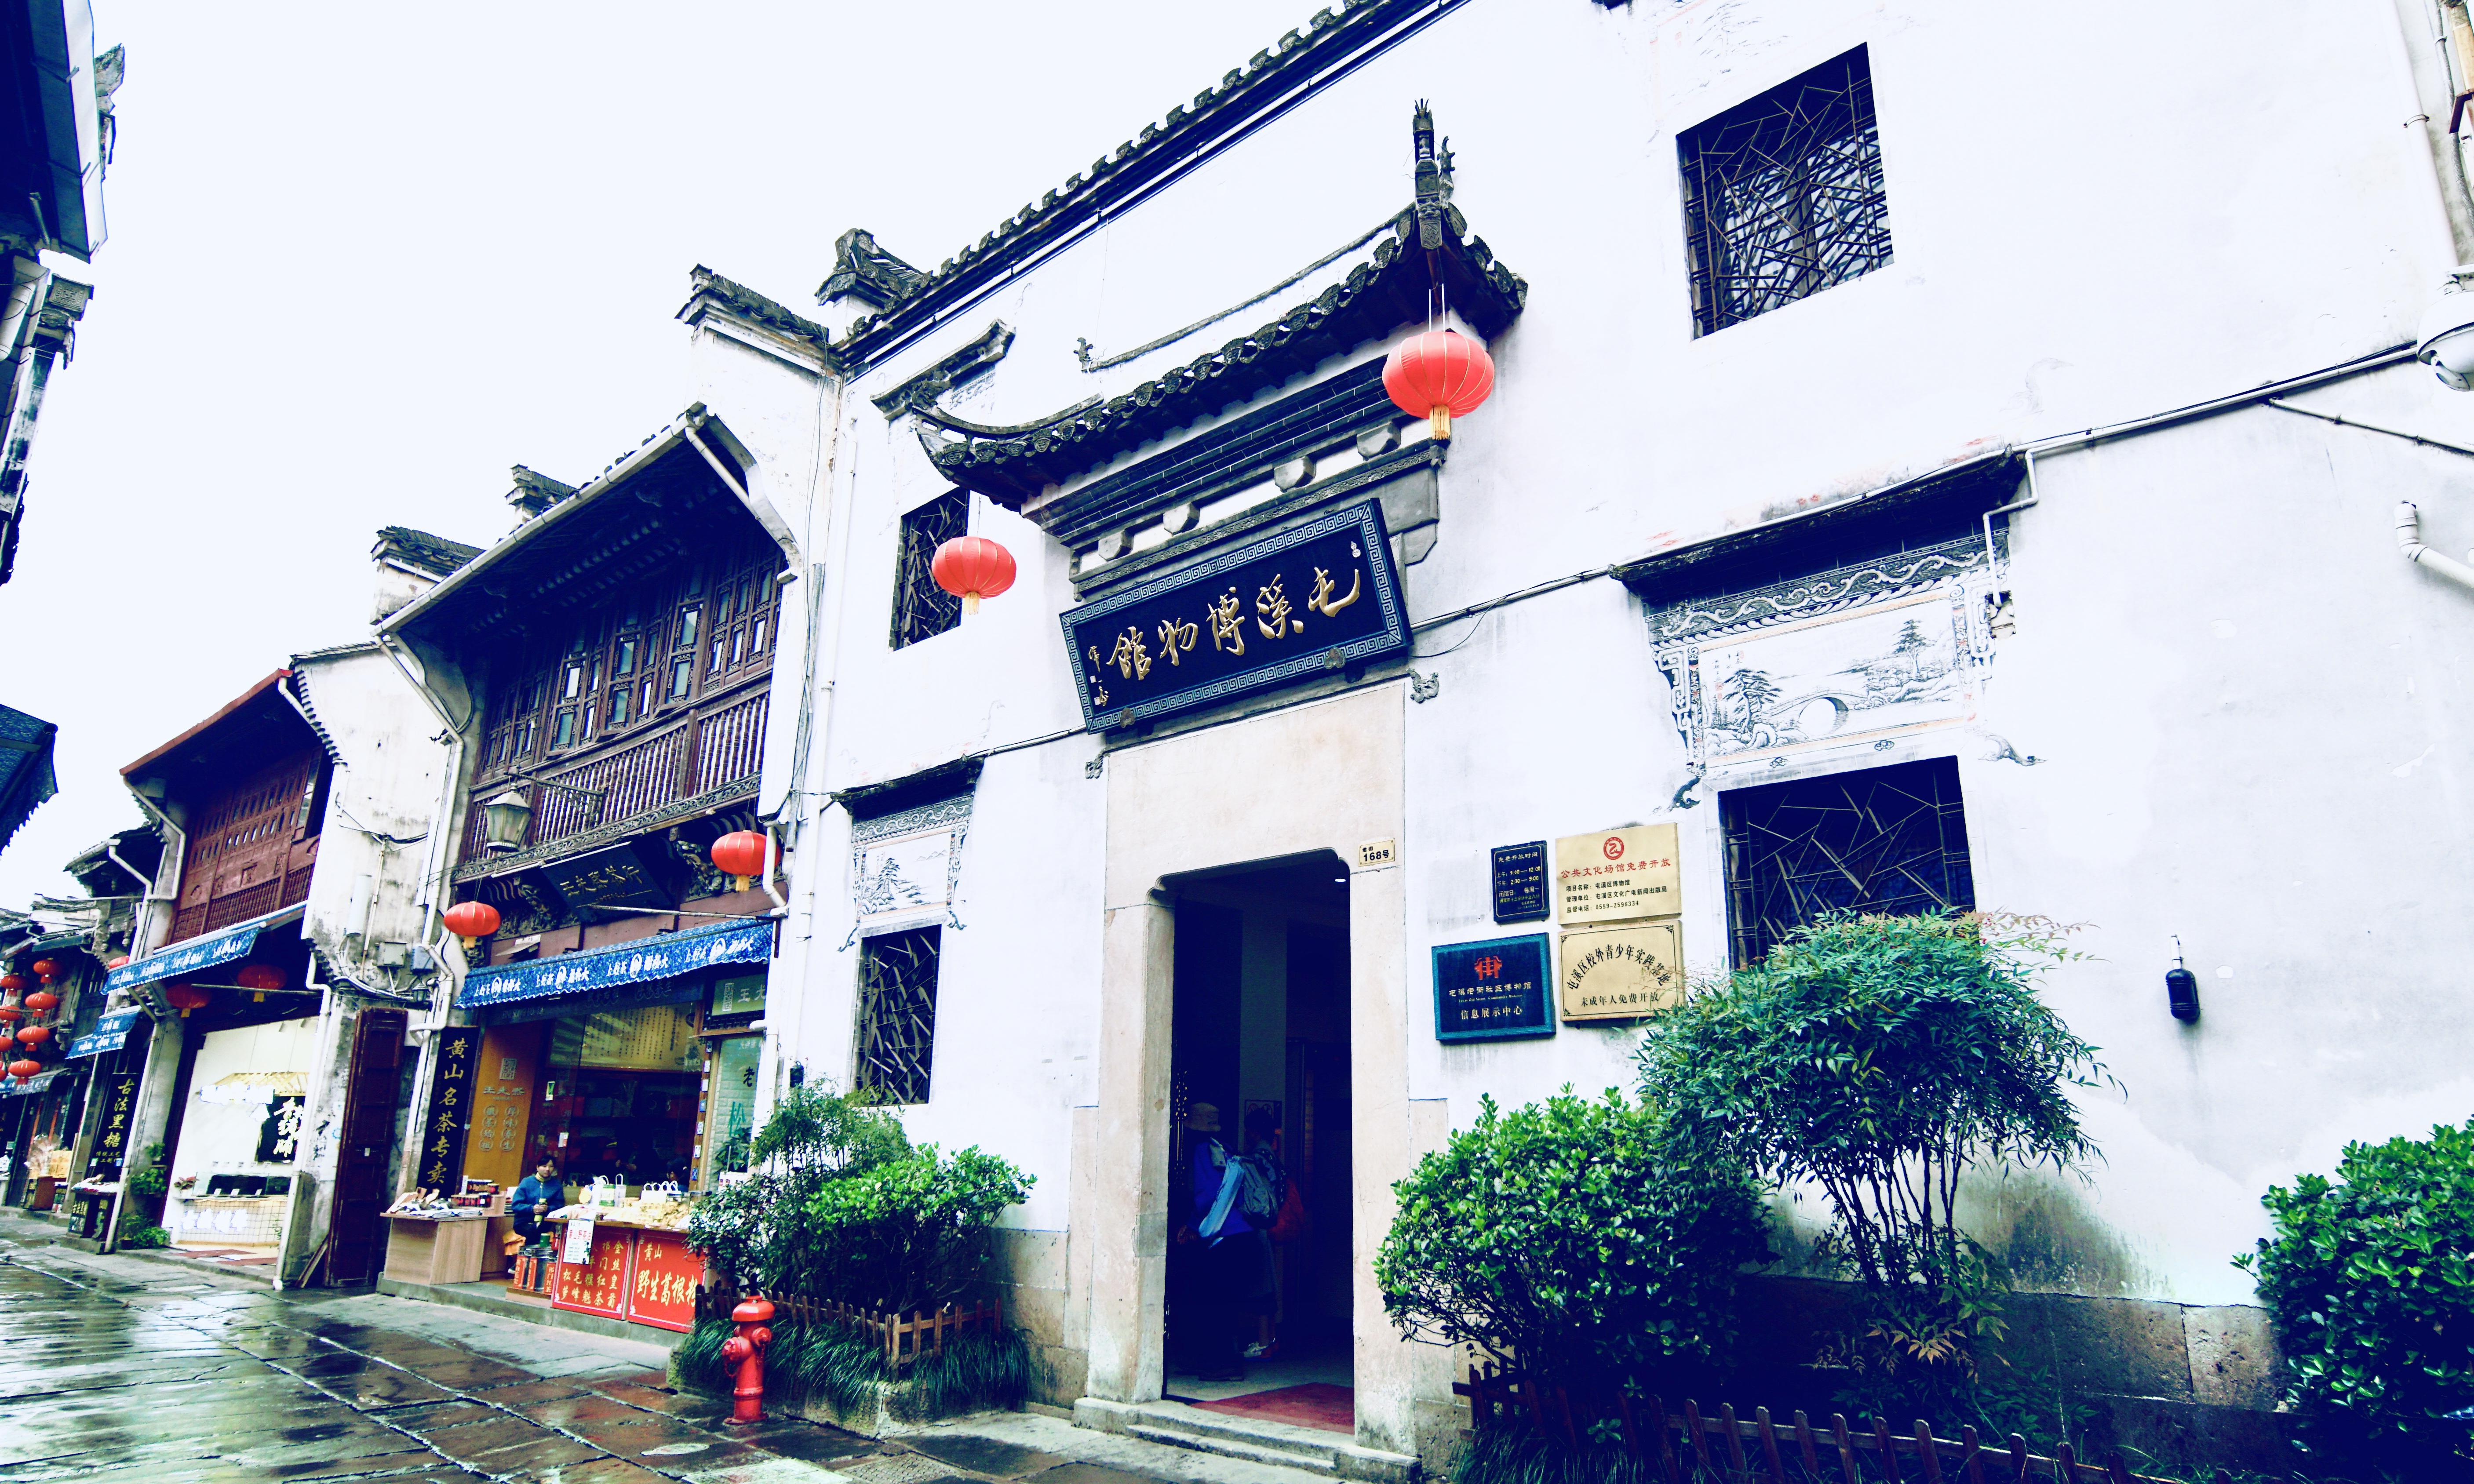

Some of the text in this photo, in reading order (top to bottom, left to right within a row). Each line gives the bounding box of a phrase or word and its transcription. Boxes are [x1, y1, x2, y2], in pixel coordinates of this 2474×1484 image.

[1363, 849, 1389, 862] 168号
[1498, 851, 1538, 863] 免费开放时间
[1561, 858, 1671, 879] 公共文化场馆免费开放
[1595, 879, 1630, 889] 屯溪区博物馆
[1595, 886, 1667, 900] 屯溪区文化广电新闻出版局
[1596, 901, 1639, 910] 0559-2596334
[1566, 943, 1672, 990] 屯溪区校外青少年实践基地
[1448, 982, 1532, 997] 屯溪老街社区博物馆
[1581, 991, 1659, 1007] 未成年人免费开放
[1461, 1005, 1523, 1020] 信息展示中心
[743, 1066, 755, 1087] 老
[103, 1078, 135, 1148] 古法黑糖
[426, 1037, 469, 1184] 黄山名茶专卖
[644, 1241, 663, 1262] 黄山
[594, 1241, 611, 1306] 祁门红茶
[607, 1240, 624, 1309] 金丝皇菊
